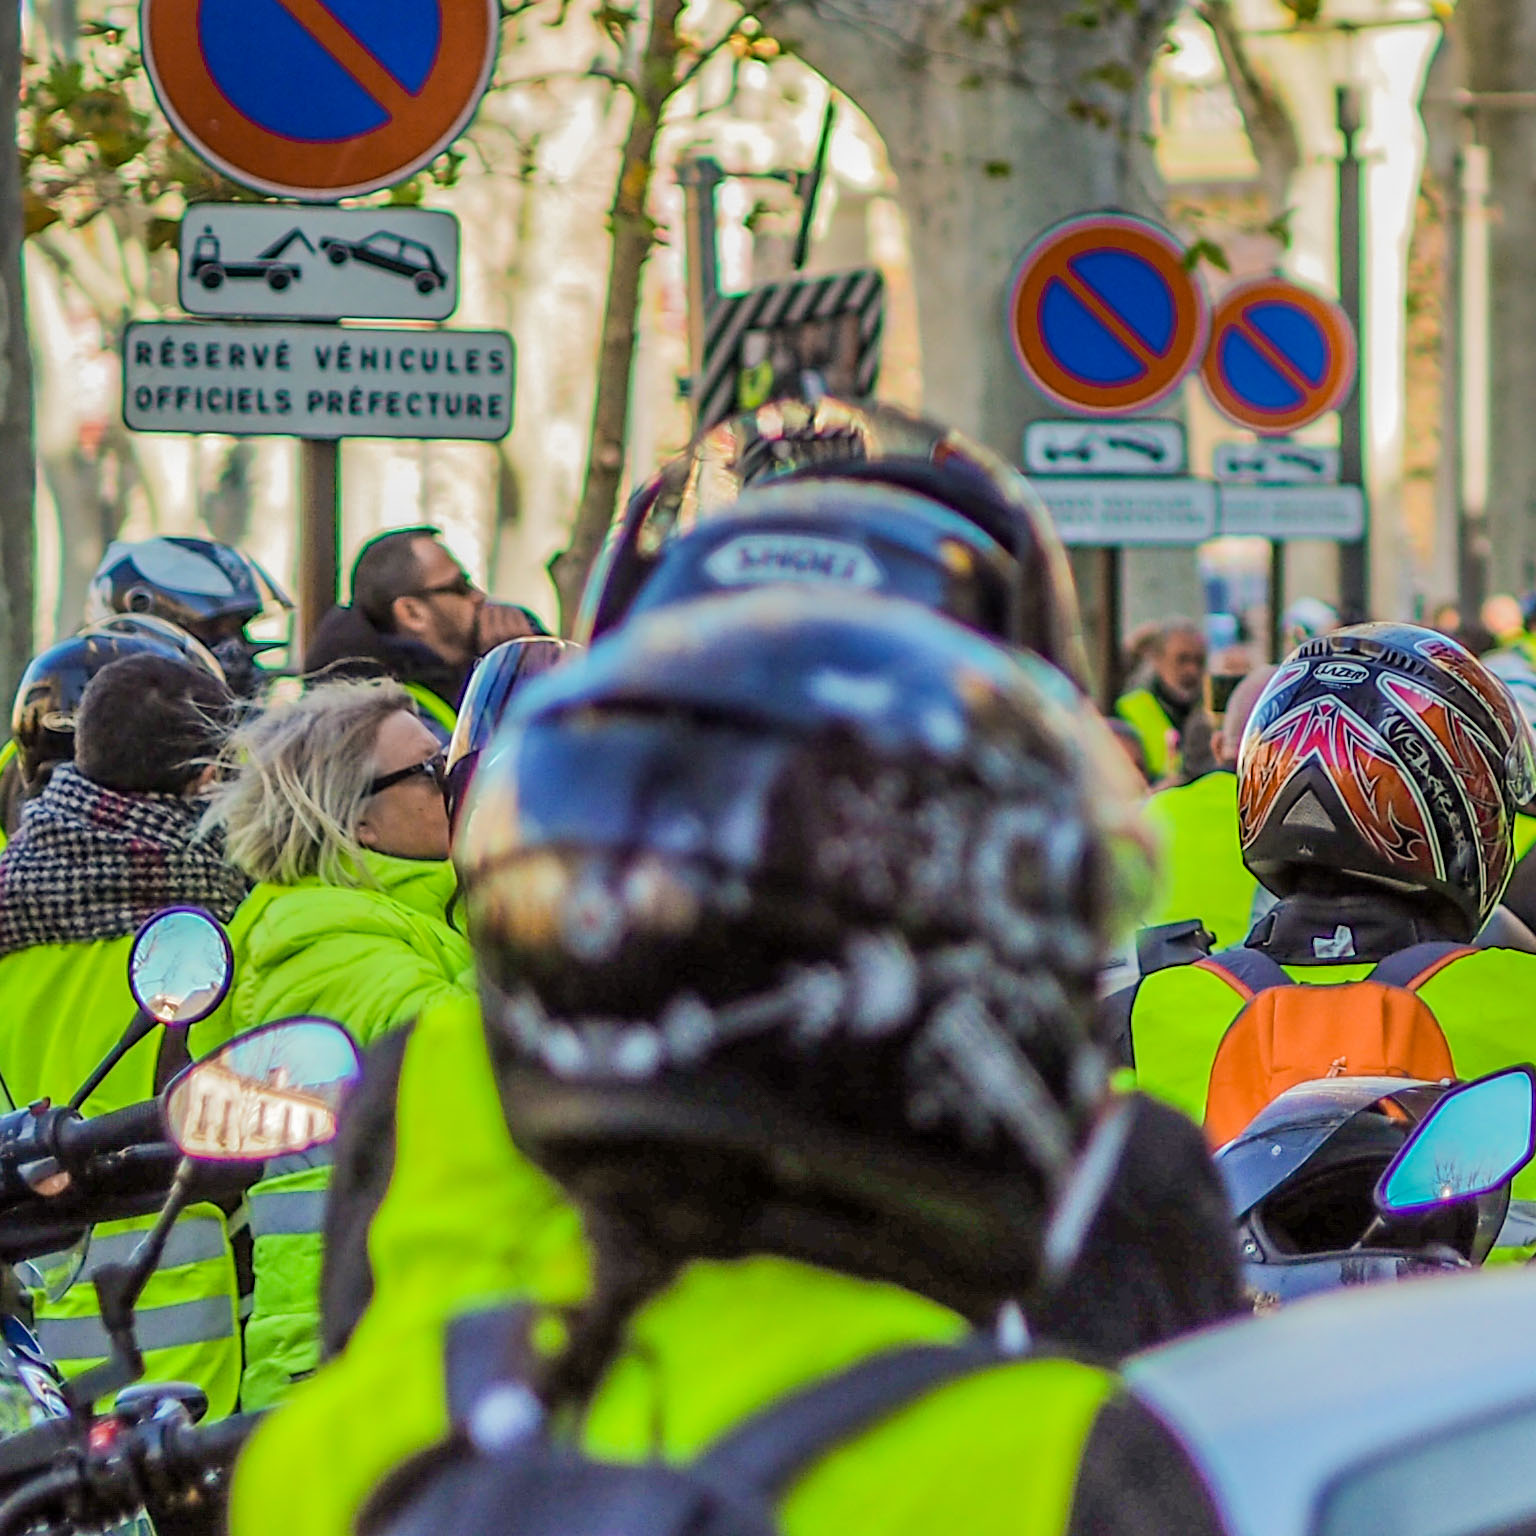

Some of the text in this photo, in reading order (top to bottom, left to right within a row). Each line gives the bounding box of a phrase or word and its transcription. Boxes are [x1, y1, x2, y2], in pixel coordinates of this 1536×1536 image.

[134, 336, 505, 377] RÉSERVÉ VÉHICULES
[134, 384, 504, 421] OFFICIELS PRÉFECTURE
[1314, 664, 1367, 681] LAZER
